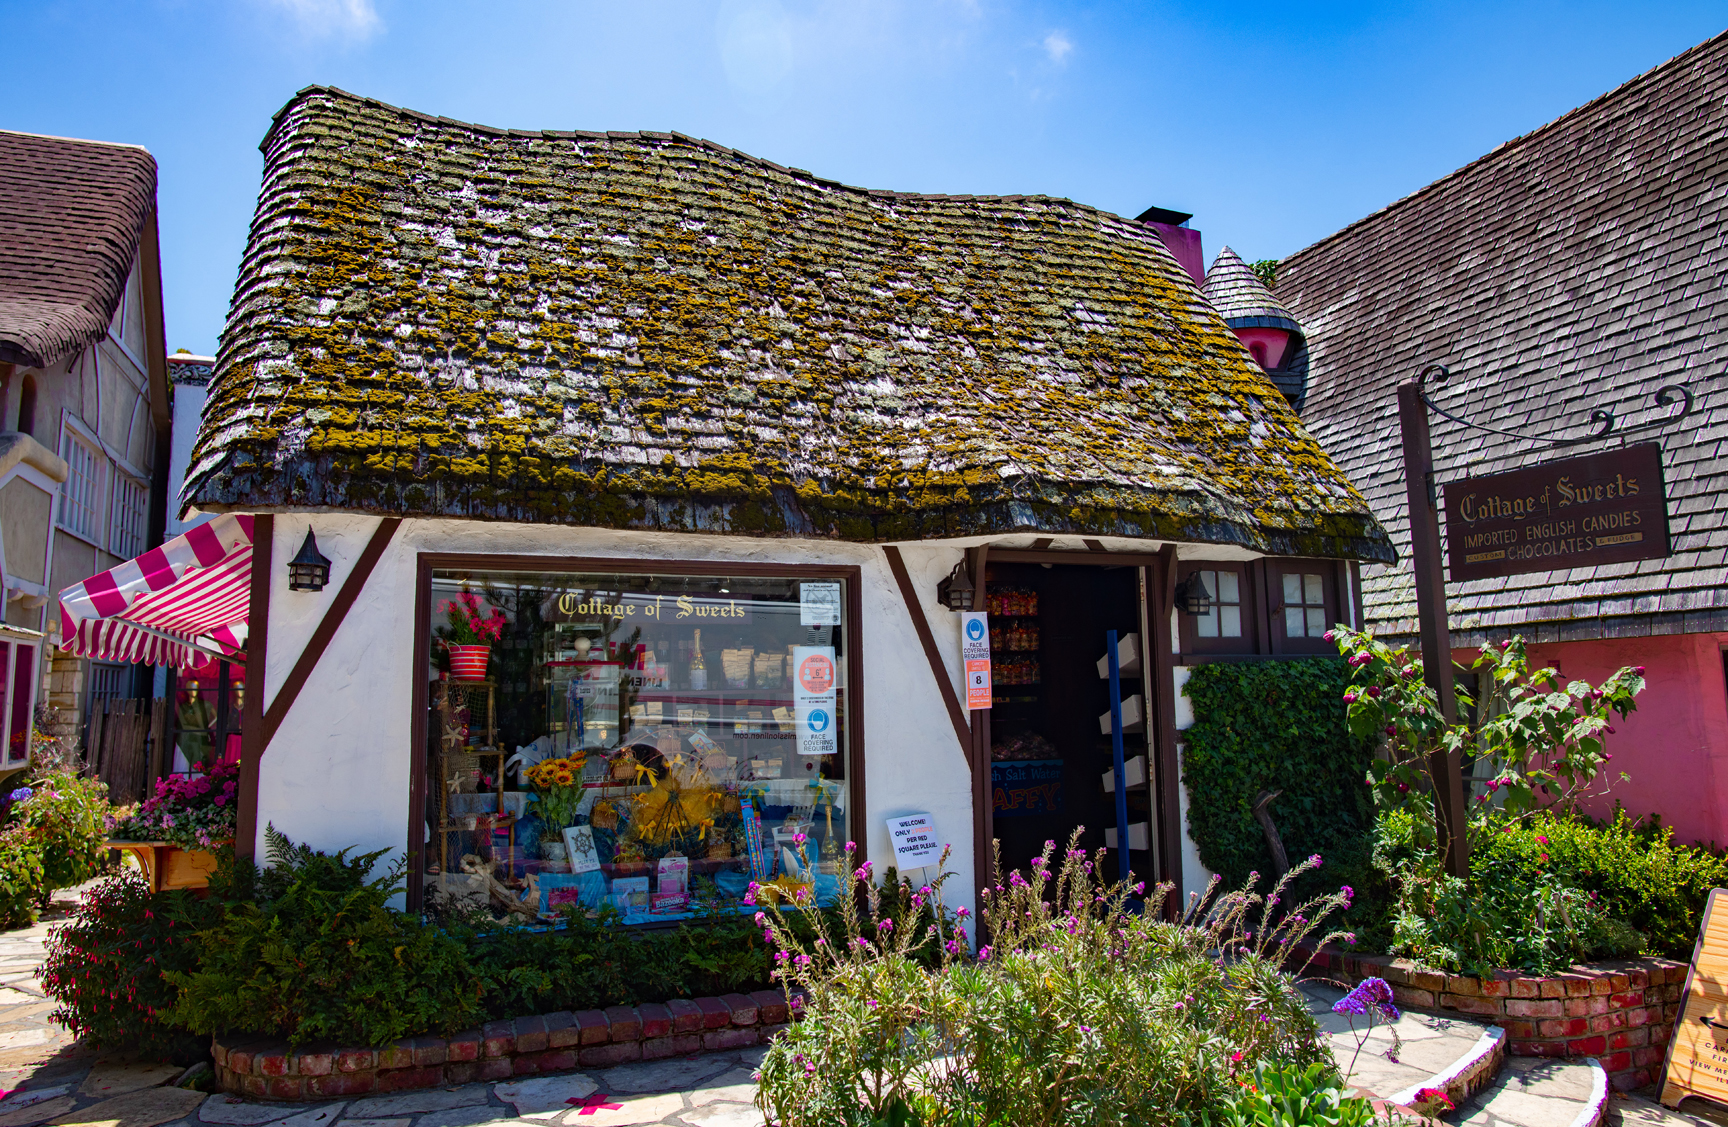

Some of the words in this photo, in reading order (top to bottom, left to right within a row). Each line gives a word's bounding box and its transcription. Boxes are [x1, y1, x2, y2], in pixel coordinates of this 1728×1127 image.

[1460, 493, 1536, 528] Cottage
[1540, 485, 1551, 518] of
[1556, 473, 1640, 508] Sweets
[1464, 529, 1518, 549] IMPORTED
[1526, 519, 1576, 541] ENGLISH
[1582, 510, 1642, 532] CANDIES
[1467, 551, 1503, 562] CUSTOM
[1507, 535, 1594, 560] CHOCOLATES
[1607, 534, 1636, 544] FUDGE
[558, 592, 636, 620] Cottage
[644, 595, 665, 621] of
[675, 594, 746, 620] Sweets
[976, 676, 982, 684] 8
[1006, 768, 1027, 781] Salt
[1031, 767, 1060, 780] Water
[992, 783, 1060, 812] AFFY
[898, 844, 920, 854] SQUARE
[656, 897, 685, 908] Bazooka
[1689, 1059, 1711, 1070] VIEW
